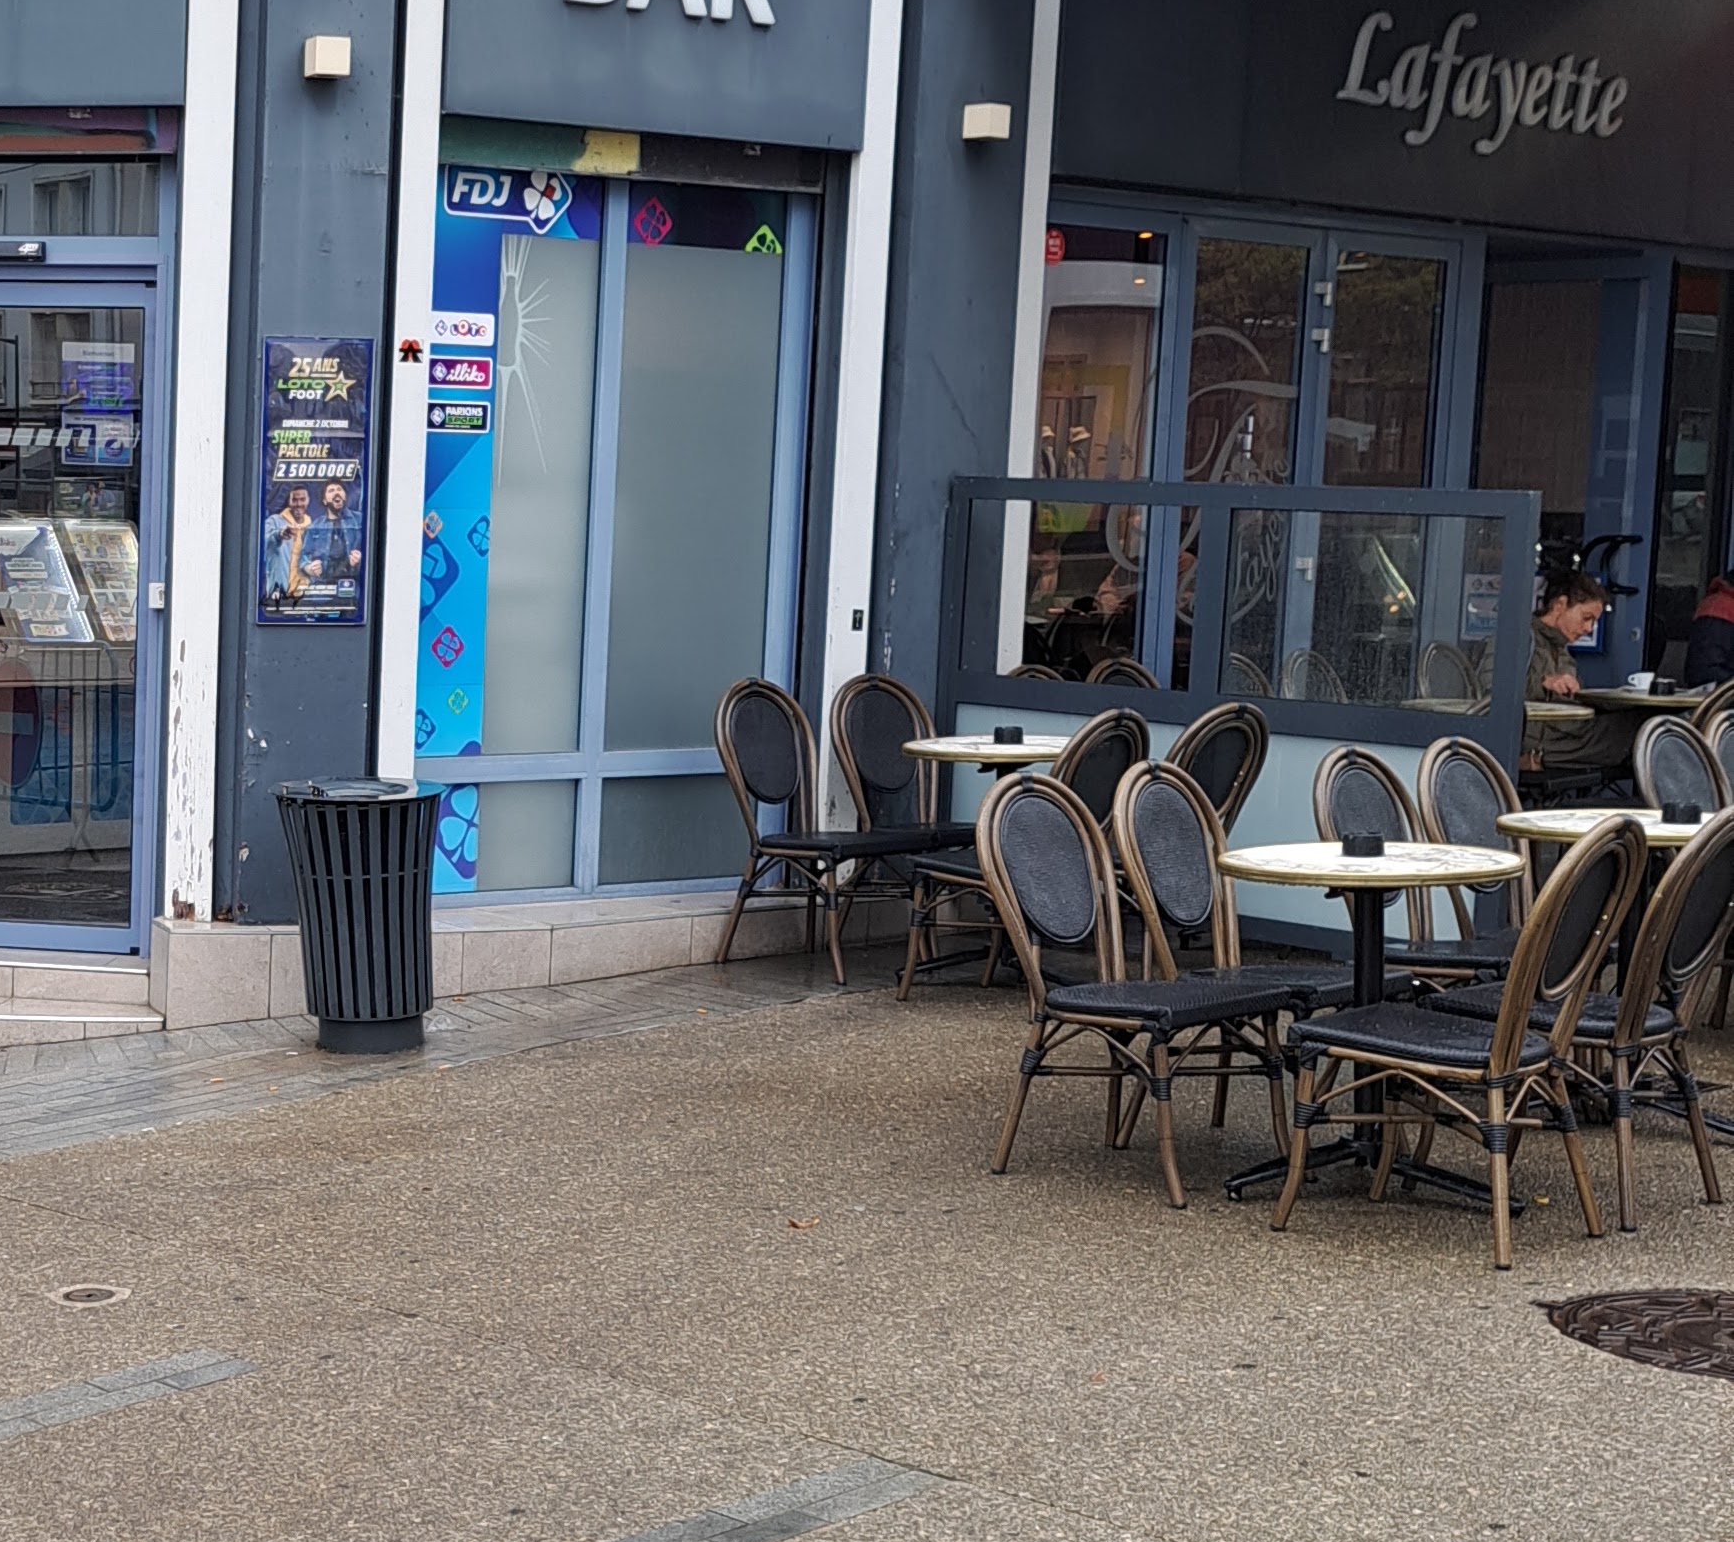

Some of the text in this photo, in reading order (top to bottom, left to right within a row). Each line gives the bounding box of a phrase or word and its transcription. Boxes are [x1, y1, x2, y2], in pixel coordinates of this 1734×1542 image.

[1336, 12, 1630, 157] Lafayette
[451, 171, 514, 208] FDJ
[449, 318, 489, 338] LOTO
[288, 357, 341, 378] 25 ANS
[446, 362, 486, 384] illiko
[277, 378, 326, 390] LOTO
[288, 389, 324, 400] FOOT
[445, 406, 484, 418] PARIONS
[446, 417, 482, 426] SPORT
[272, 429, 313, 444] SUPER
[278, 444, 331, 458] PACTOLE
[276, 463, 287, 477] 2
[288, 463, 316, 478] 500
